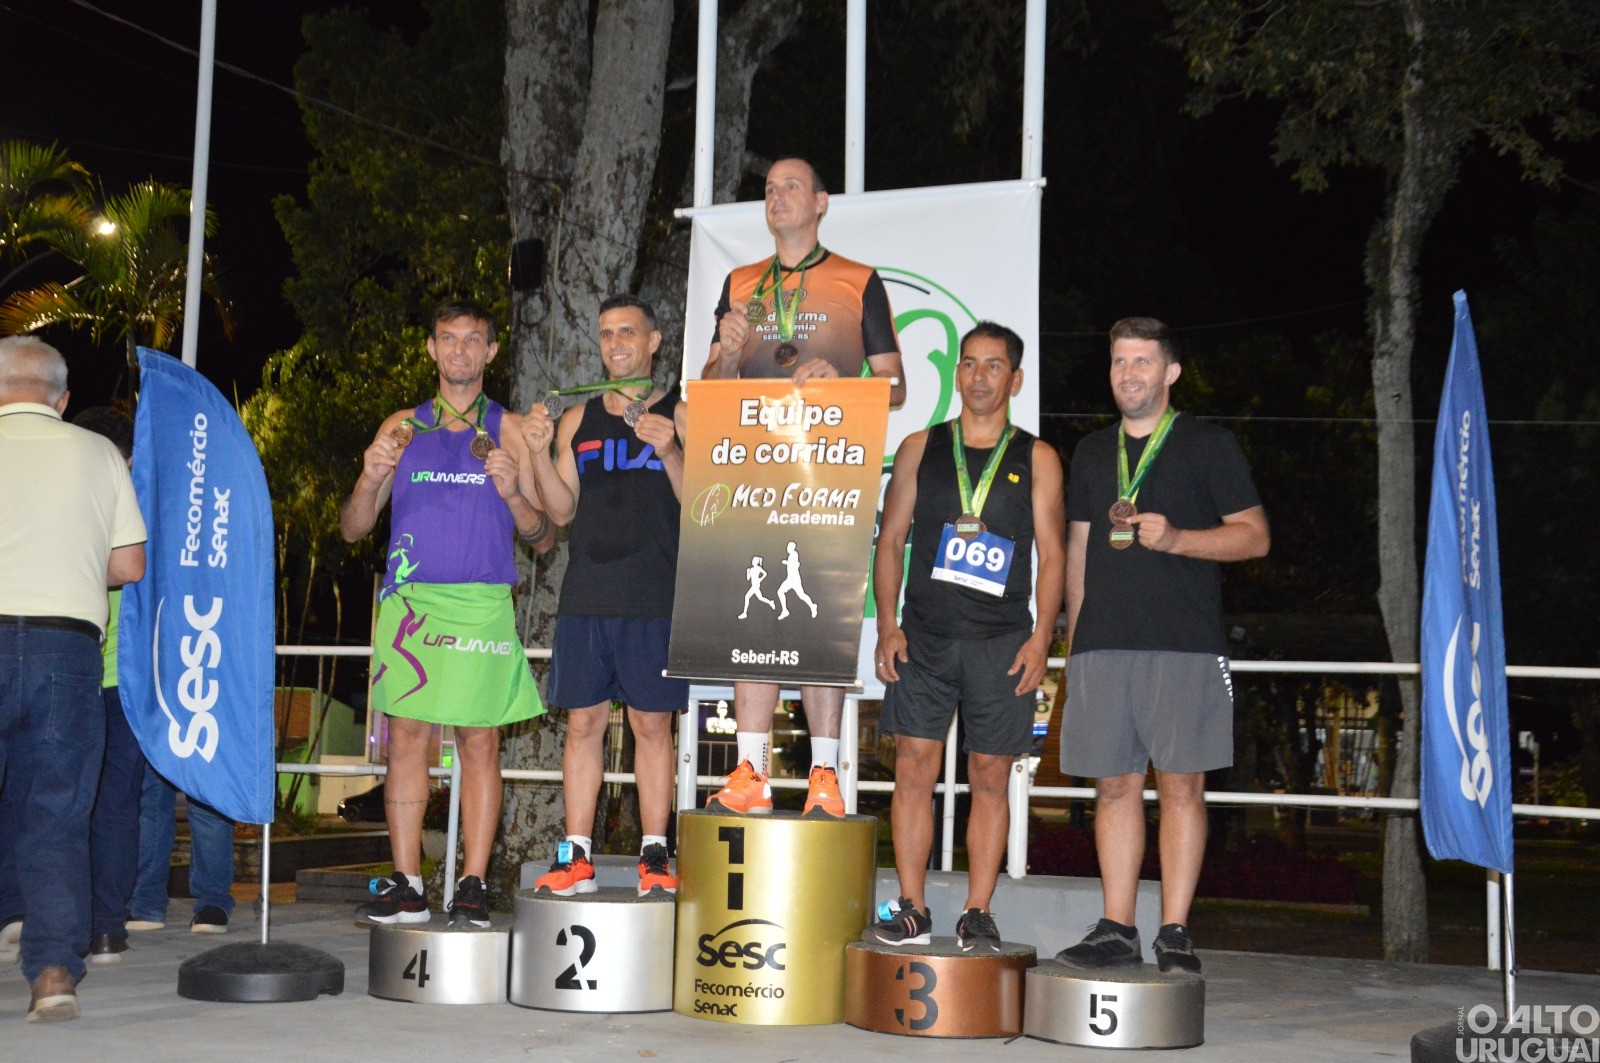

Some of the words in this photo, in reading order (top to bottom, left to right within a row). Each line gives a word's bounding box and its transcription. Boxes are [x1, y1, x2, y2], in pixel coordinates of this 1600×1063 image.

[755, 323, 817, 332] Acamia
[785, 311, 828, 322] rma
[740, 399, 843, 432] Equipe
[711, 437, 747, 465] de
[754, 437, 865, 466] corrida
[180, 412, 208, 567] Fecomércio
[411, 470, 487, 485] URUNNERS
[208, 487, 231, 568] Senac
[767, 510, 855, 526] Academia
[946, 537, 1005, 572] 069
[423, 632, 513, 655] URUNNE
[731, 648, 799, 665] Seberi-RS
[168, 594, 223, 764] Sesc
[718, 826, 745, 910] 1
[402, 949, 431, 988] 4
[555, 924, 598, 990] 2
[696, 933, 787, 971] Sesc
[694, 978, 785, 999] Fecomércio
[895, 961, 939, 1030] 3
[694, 999, 738, 1017] Senac
[1089, 993, 1118, 1036] 5
